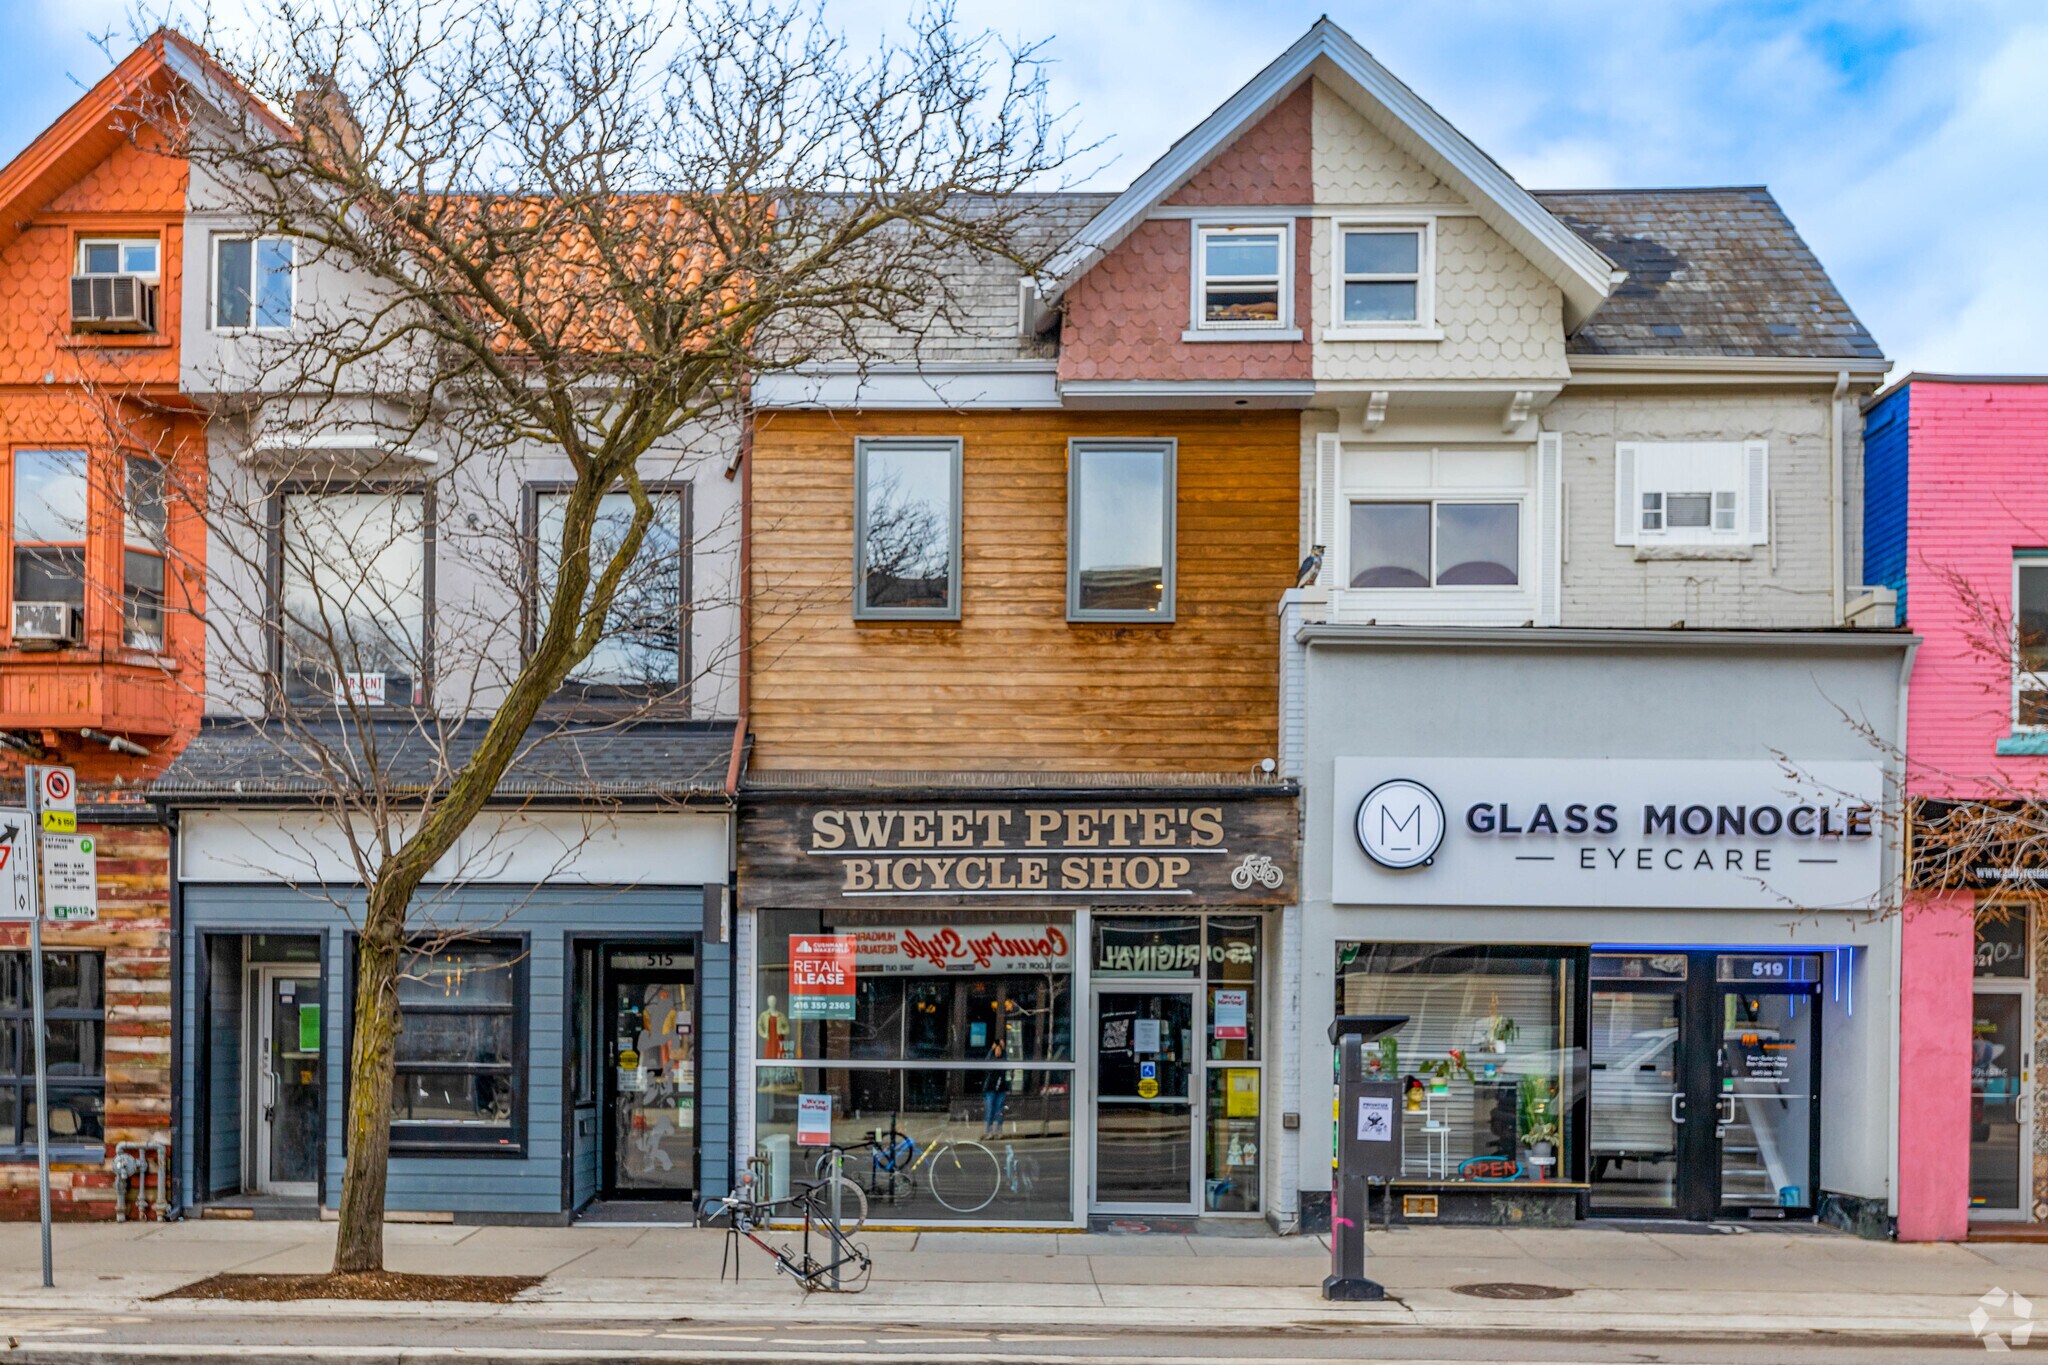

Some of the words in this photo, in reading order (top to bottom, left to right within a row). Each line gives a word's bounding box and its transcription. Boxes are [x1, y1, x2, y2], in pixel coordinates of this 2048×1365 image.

[338, 677, 355, 689] FR
[360, 677, 382, 689] ENT
[1466, 802, 1619, 835] GLASS
[1643, 804, 1873, 837] MONOCLE
[812, 809, 1012, 849] SWEET
[1024, 807, 1225, 848] PETE'S
[1580, 848, 1771, 871] EYECARE
[842, 857, 1048, 890] BICYCLE
[1061, 856, 1191, 890] SHOP
[647, 954, 673, 966] 515
[794, 961, 843, 972] RETAIL
[1752, 961, 1783, 976] 519
[799, 974, 845, 985] LEASE
[1463, 1161, 1517, 1178] OPEN
